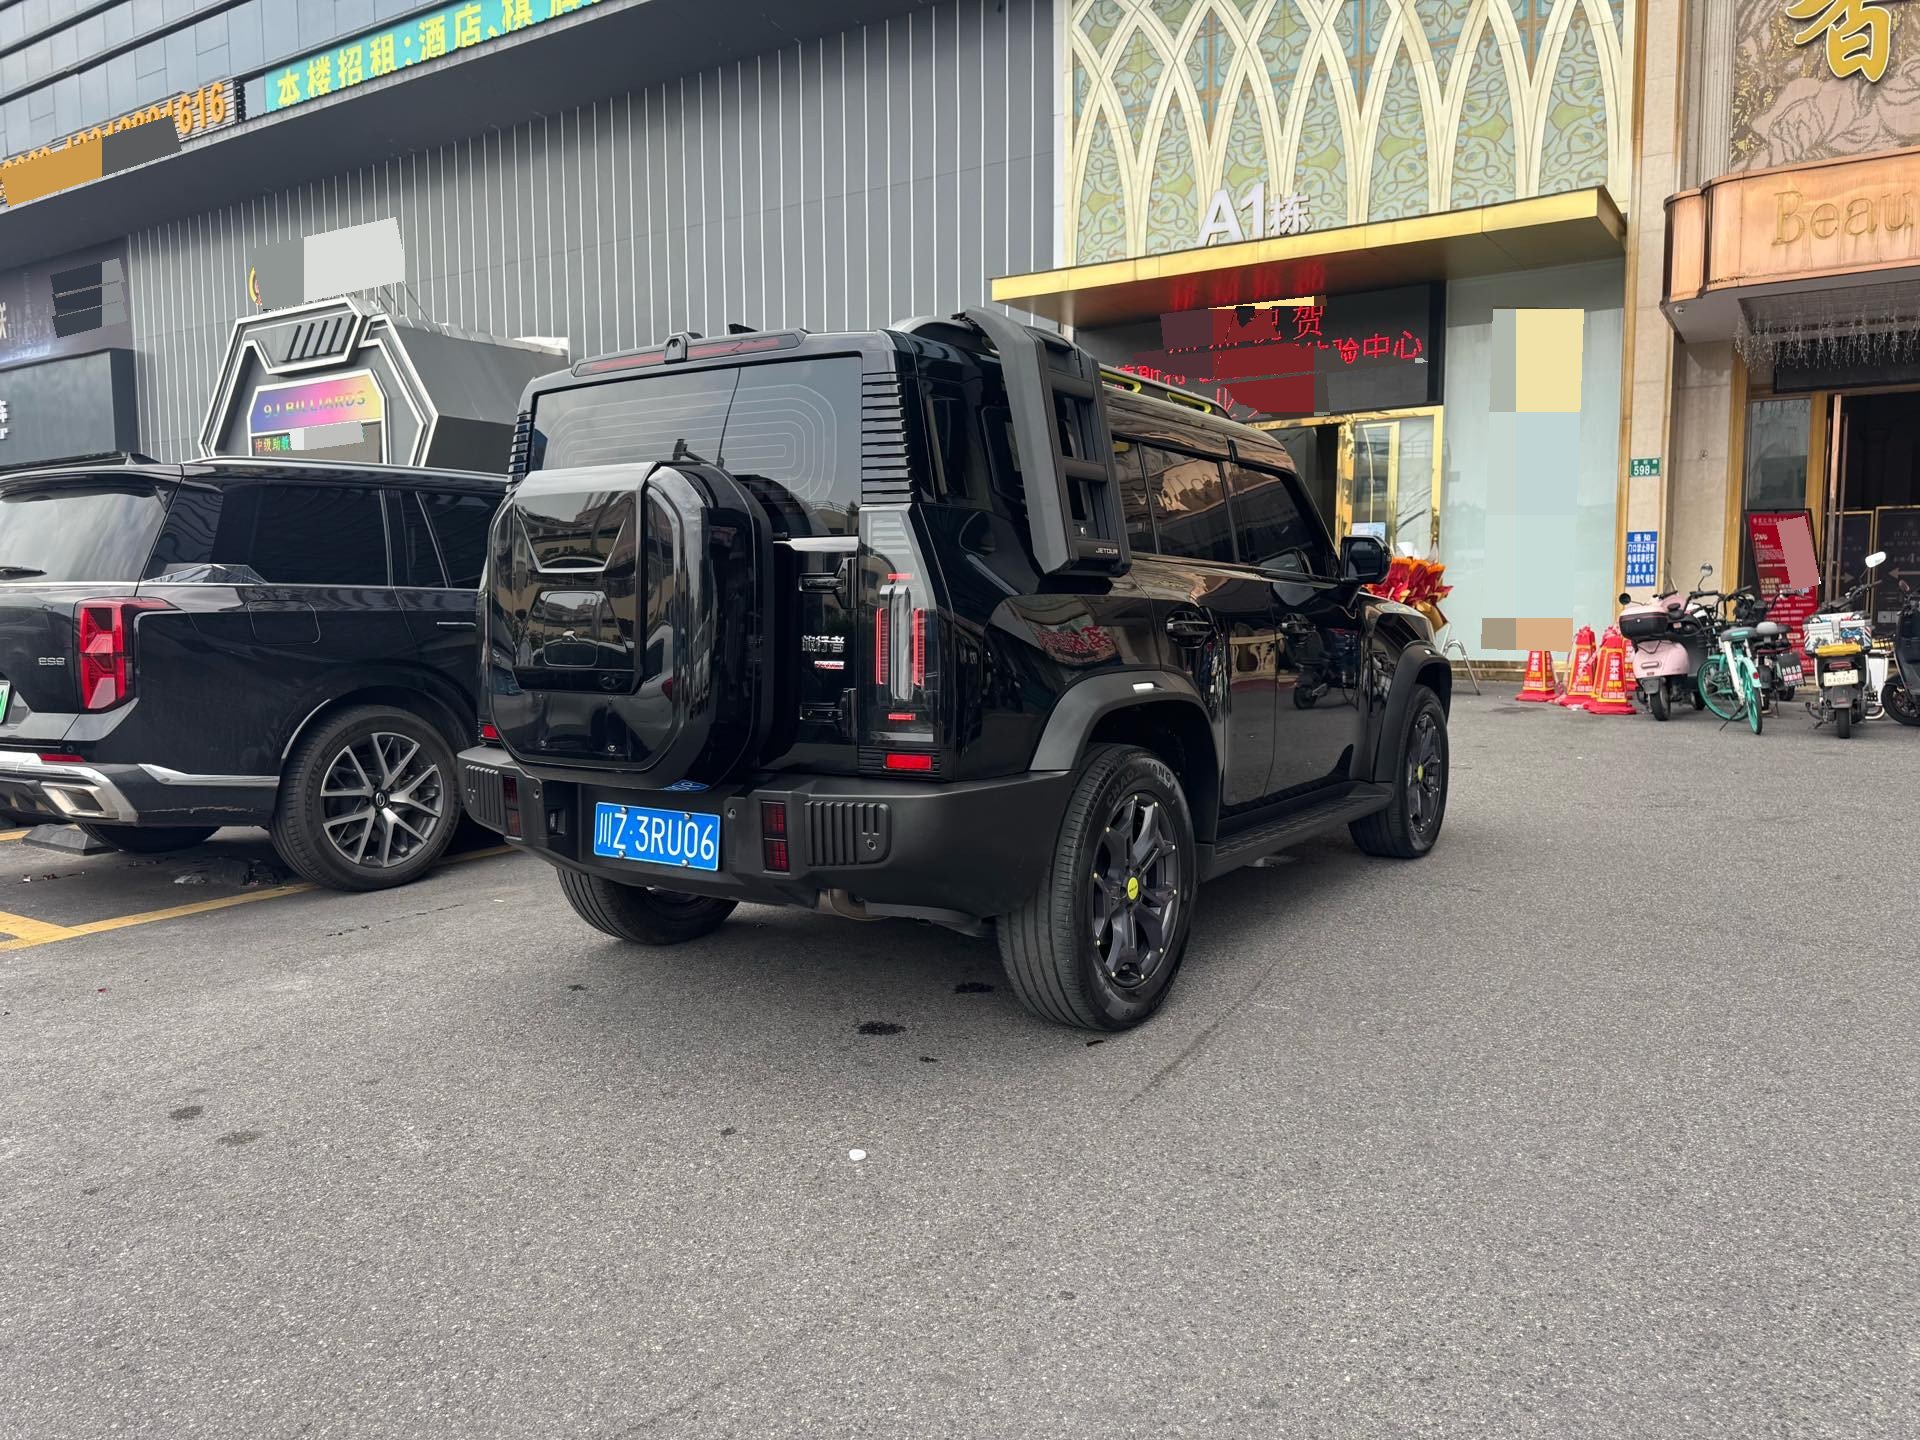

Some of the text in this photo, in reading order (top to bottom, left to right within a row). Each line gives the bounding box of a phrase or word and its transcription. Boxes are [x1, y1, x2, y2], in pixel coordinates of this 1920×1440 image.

[276, 0, 602, 106] 本楼招租：酒店、棋
[1196, 182, 1311, 247] A1栋
[285, 391, 366, 416] BILLIARDS
[598, 812, 715, 861] 川Z·3RU06
